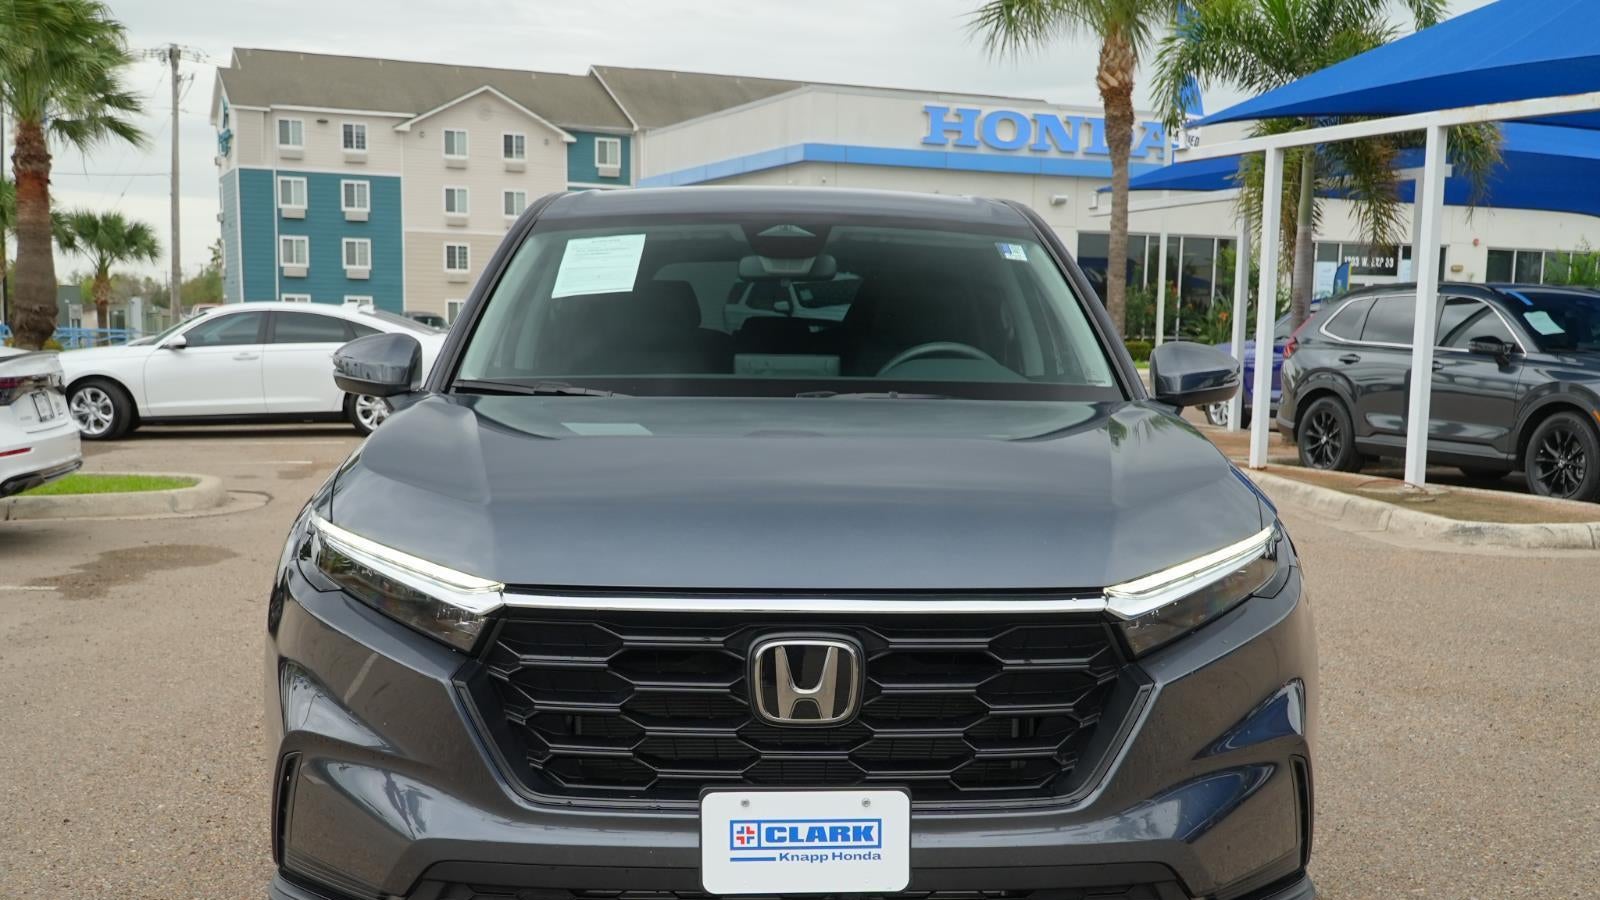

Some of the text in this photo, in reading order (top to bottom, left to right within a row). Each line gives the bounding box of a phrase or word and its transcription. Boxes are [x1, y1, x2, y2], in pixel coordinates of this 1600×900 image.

[765, 825, 874, 843] CLARK
[779, 851, 881, 863] Knapp Honda
